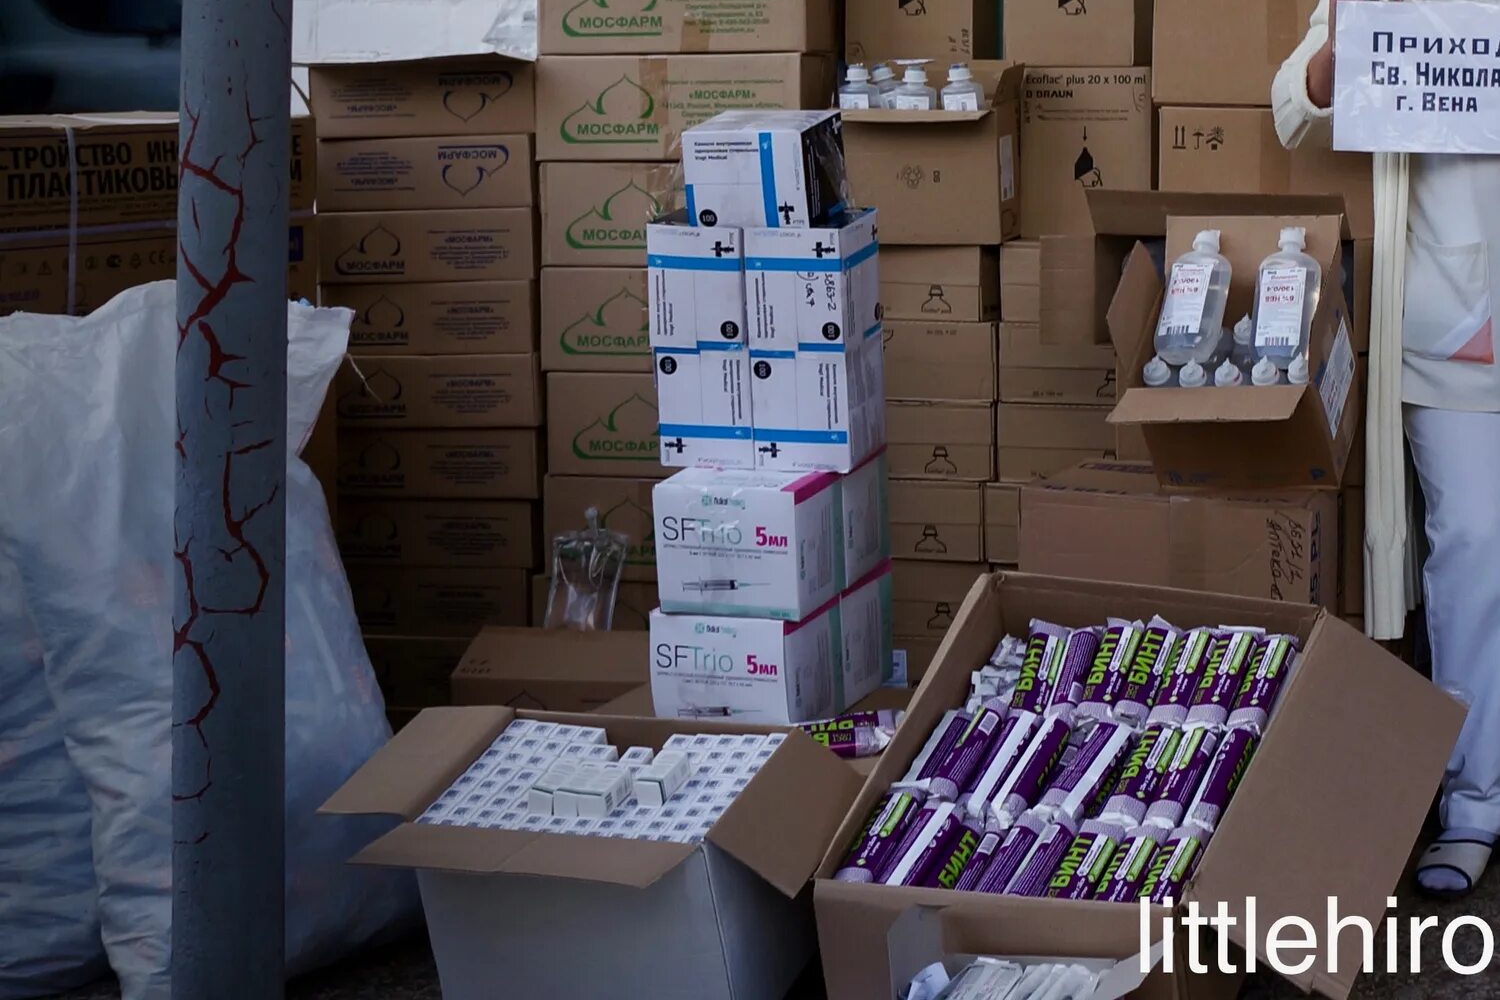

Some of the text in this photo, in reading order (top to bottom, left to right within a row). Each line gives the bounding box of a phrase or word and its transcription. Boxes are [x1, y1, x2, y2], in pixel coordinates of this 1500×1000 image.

[579, 15, 662, 28] МОСФАРМ
[1066, 75, 1085, 88] plus
[1087, 74, 1101, 85] 20
[1113, 74, 1131, 84] 100
[1134, 74, 1146, 84] ml
[1036, 89, 1073, 98] BRAUN
[577, 122, 659, 136] МОСФАРМ
[438, 150, 497, 160] МОСФАРМ
[702, 214, 715, 223] 100
[346, 261, 404, 271] МОСФАРМ
[577, 334, 649, 348] МОСФАР
[589, 439, 658, 453] МОСФАР
[756, 526, 788, 548] 5мл
[656, 644, 777, 676] SFTrio 5мл
[1016, 637, 1046, 692] БИНТ
[1086, 631, 1120, 685] БИНТ
[1127, 629, 1163, 686] БИНТ
[1200, 639, 1230, 689] БИНТ
[1120, 730, 1160, 779] БИНТ
[938, 830, 977, 887] БИНТ
[1051, 836, 1093, 888] БИНТ
